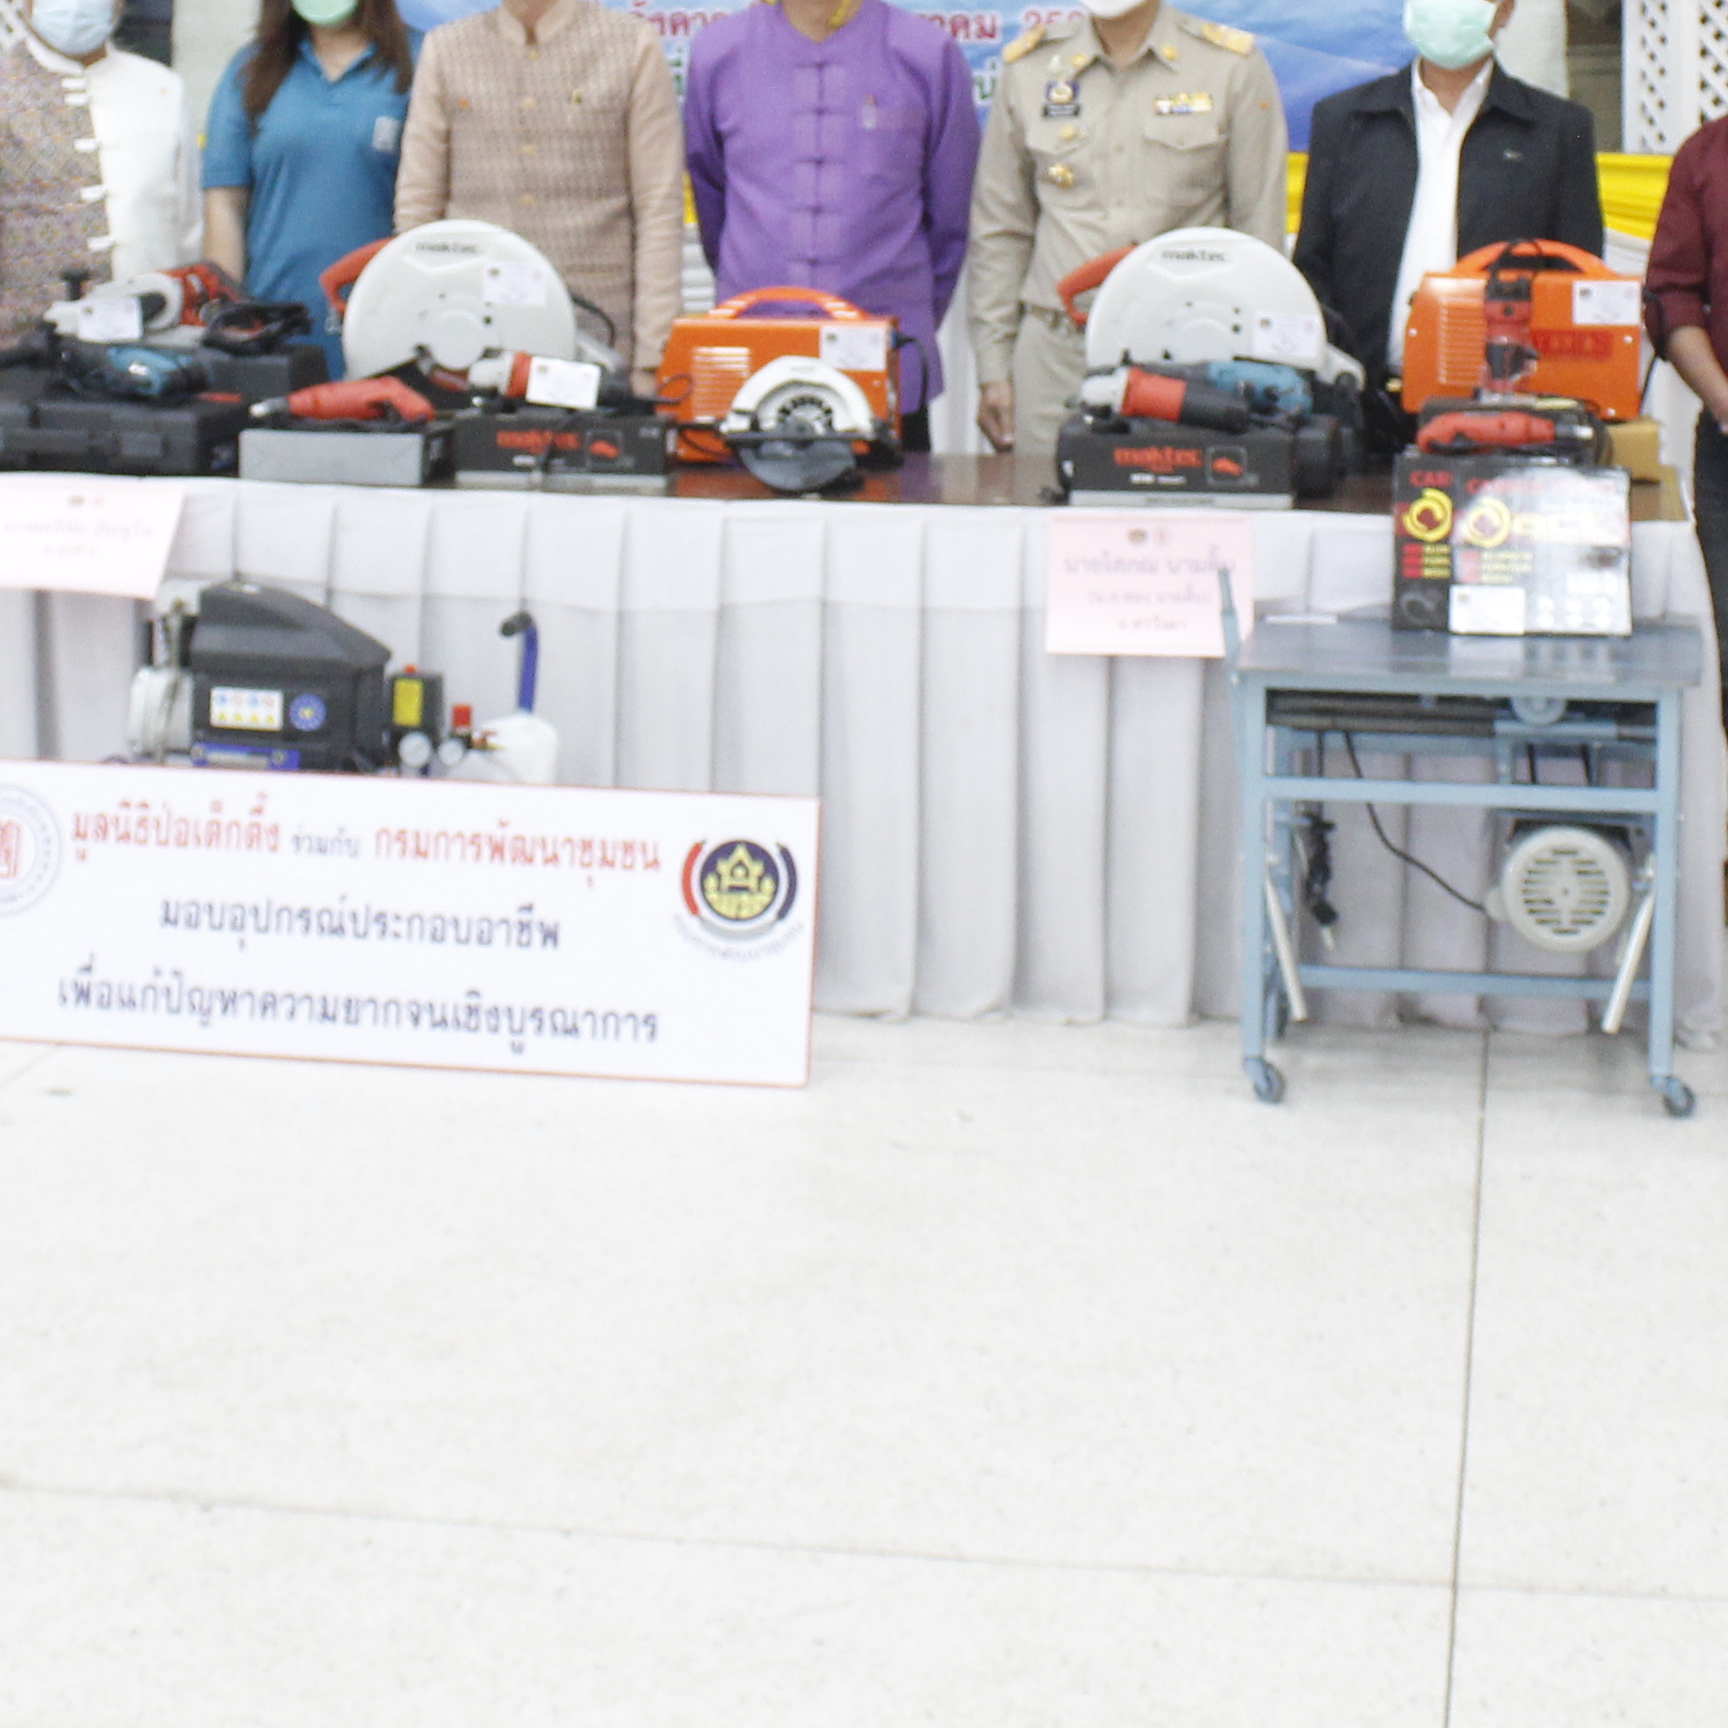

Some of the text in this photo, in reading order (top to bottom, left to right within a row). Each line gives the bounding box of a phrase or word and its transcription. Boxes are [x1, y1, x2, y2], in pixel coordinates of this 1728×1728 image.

[290, 823, 362, 860] ร่วมกับ
[373, 818, 663, 889] กรมการพัฒนาชุมชน
[158, 892, 562, 952] มอบอุปกรณ์ประกอบอาชีพ
[56, 956, 660, 1053] เพื่อแก้ปัญหาความยากจนเชิงบูรณาการ
